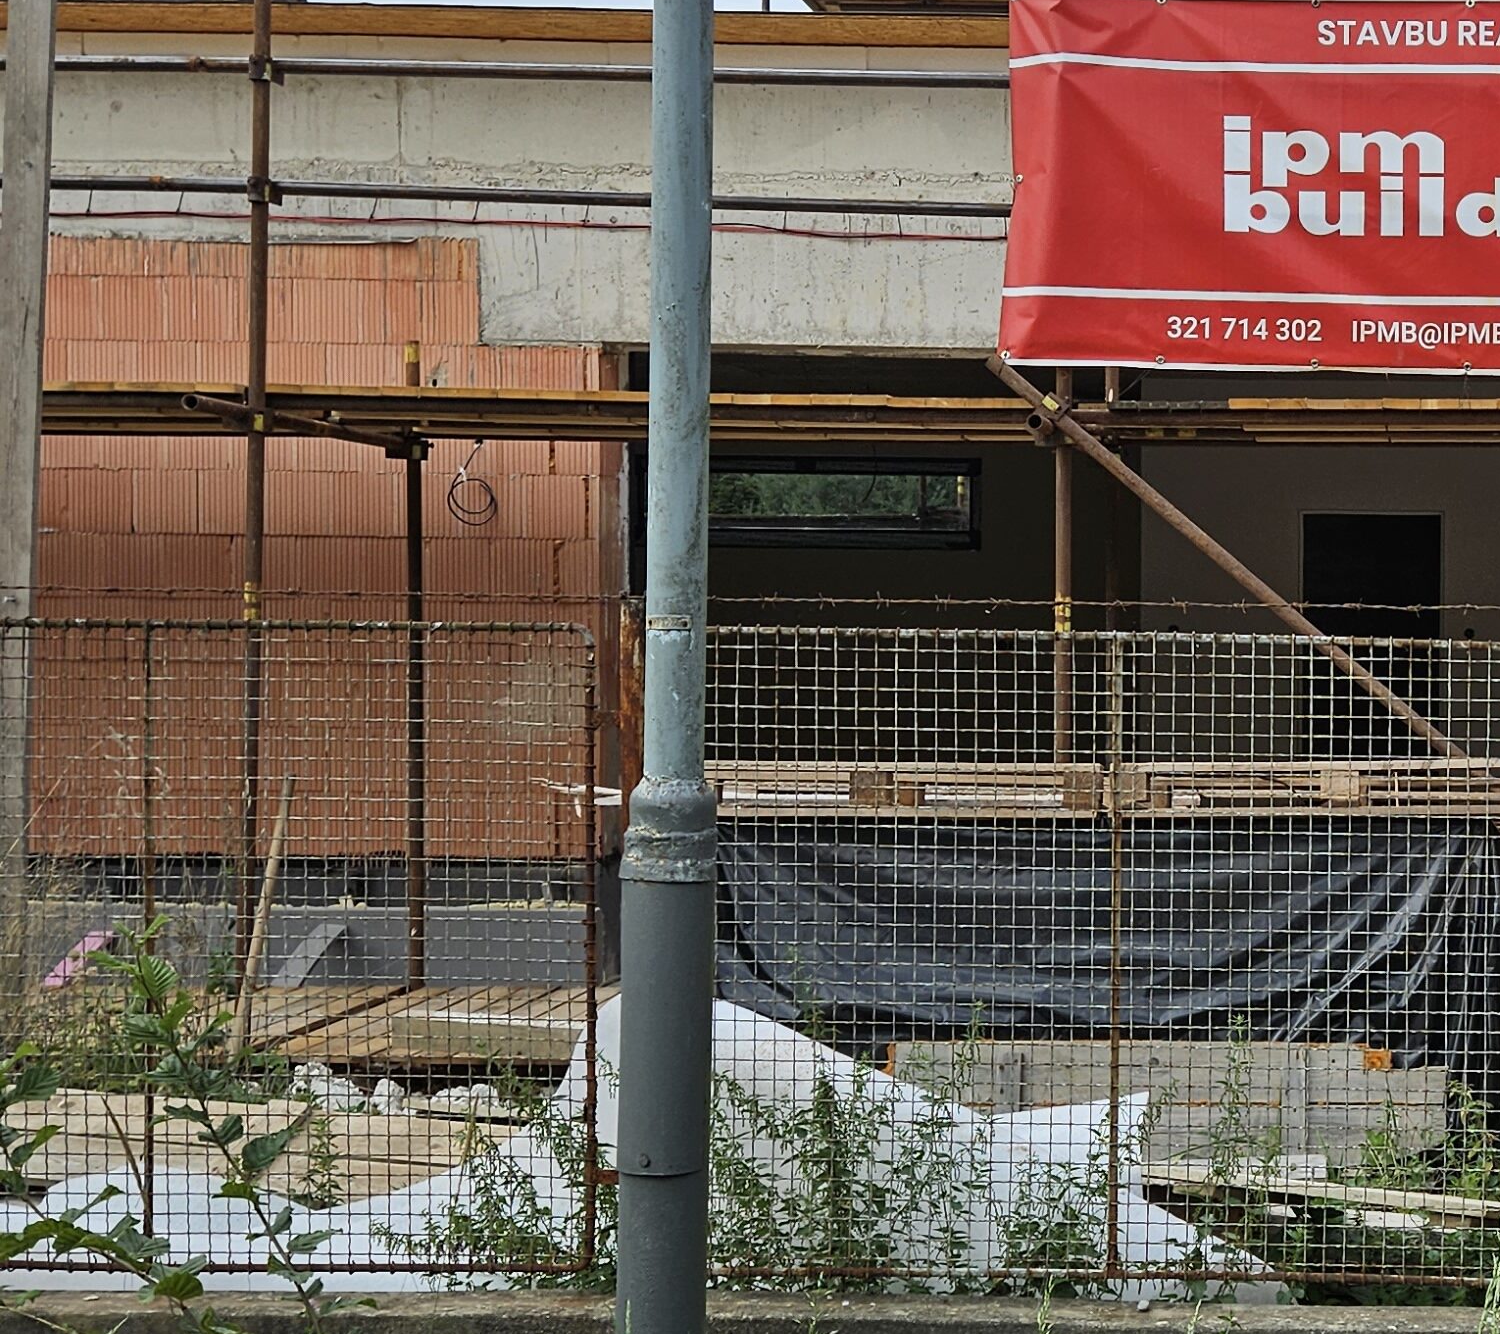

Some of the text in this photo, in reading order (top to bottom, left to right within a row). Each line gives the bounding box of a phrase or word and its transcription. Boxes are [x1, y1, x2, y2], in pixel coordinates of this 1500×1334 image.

[1317, 19, 1448, 47] STAVBU
[1223, 115, 1445, 188] ipm
[1167, 316, 1210, 339] 321
[1220, 317, 1269, 341] 714
[1275, 318, 1322, 342] 302
